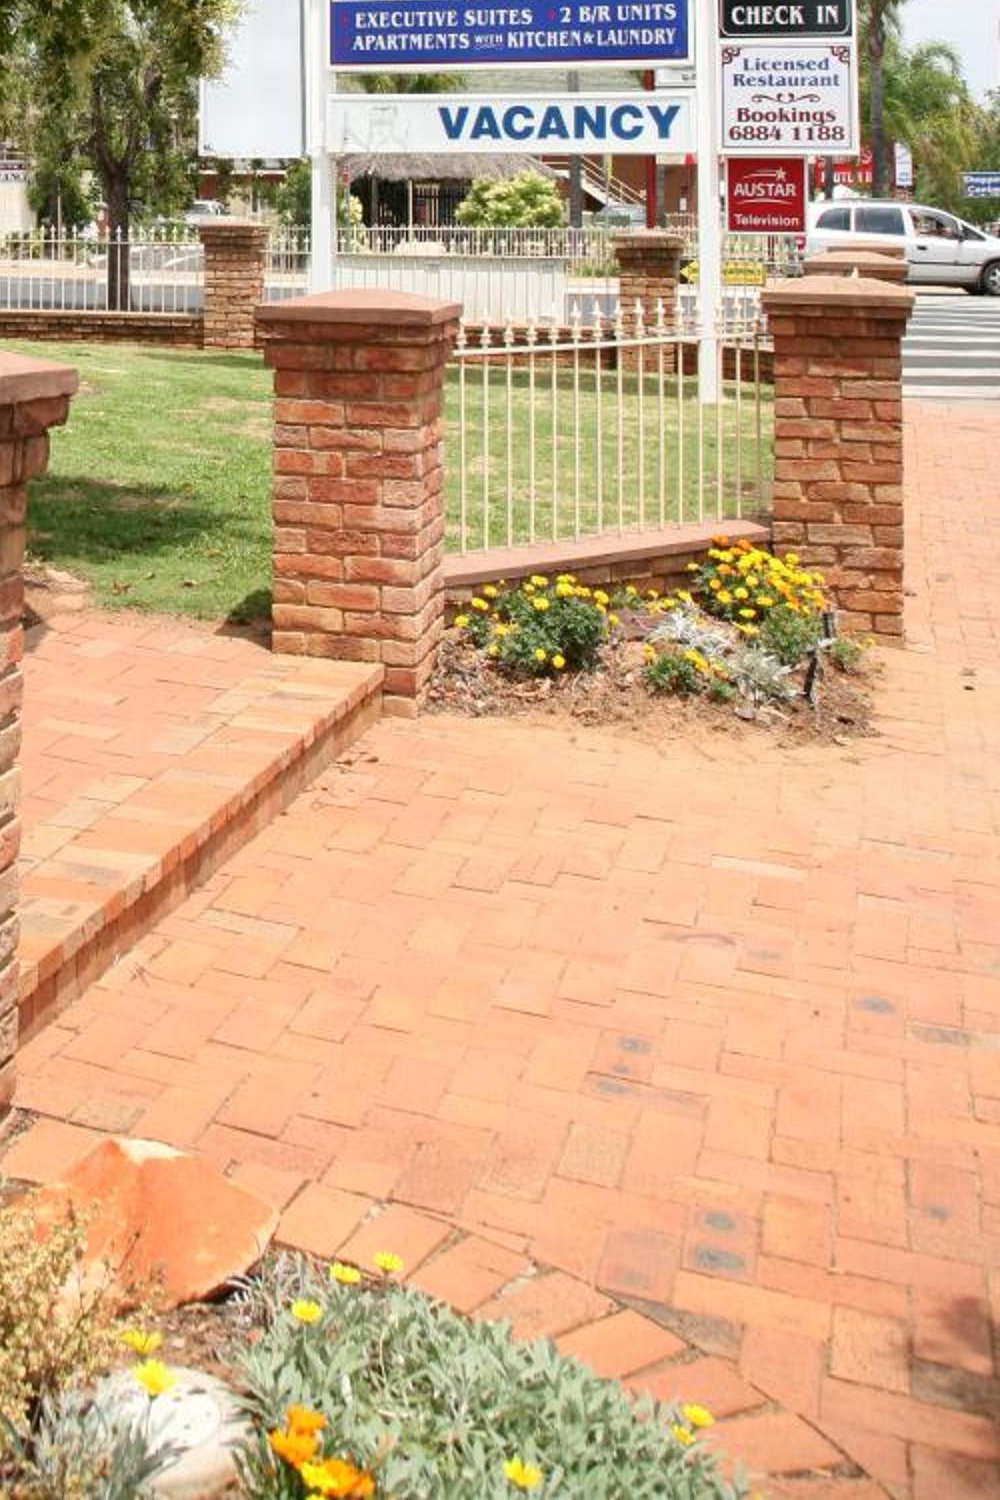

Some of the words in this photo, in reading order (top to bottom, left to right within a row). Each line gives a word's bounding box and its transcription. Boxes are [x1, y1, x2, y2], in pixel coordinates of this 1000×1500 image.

[355, 11, 458, 28] EXECUTIVE
[464, 8, 533, 26] SUITES
[559, 6, 572, 23] 2
[578, 5, 611, 24] B/R
[617, 3, 677, 21] UNITS
[731, 5, 804, 25] CHECK
[816, 4, 840, 24] IN
[353, 33, 470, 50] APARTMENTS
[507, 30, 581, 48] KITCHEN
[583, 32, 595, 45] &
[597, 28, 677, 47] LAUNDRY
[742, 56, 830, 71] Licensed
[733, 72, 841, 88] Restaurant
[439, 104, 681, 140] VACANCY
[737, 107, 836, 127] Bookings
[728, 125, 782, 141] 6884
[792, 125, 845, 141] 1188
[733, 182, 797, 198] AUSTAR
[733, 213, 799, 227] Television
